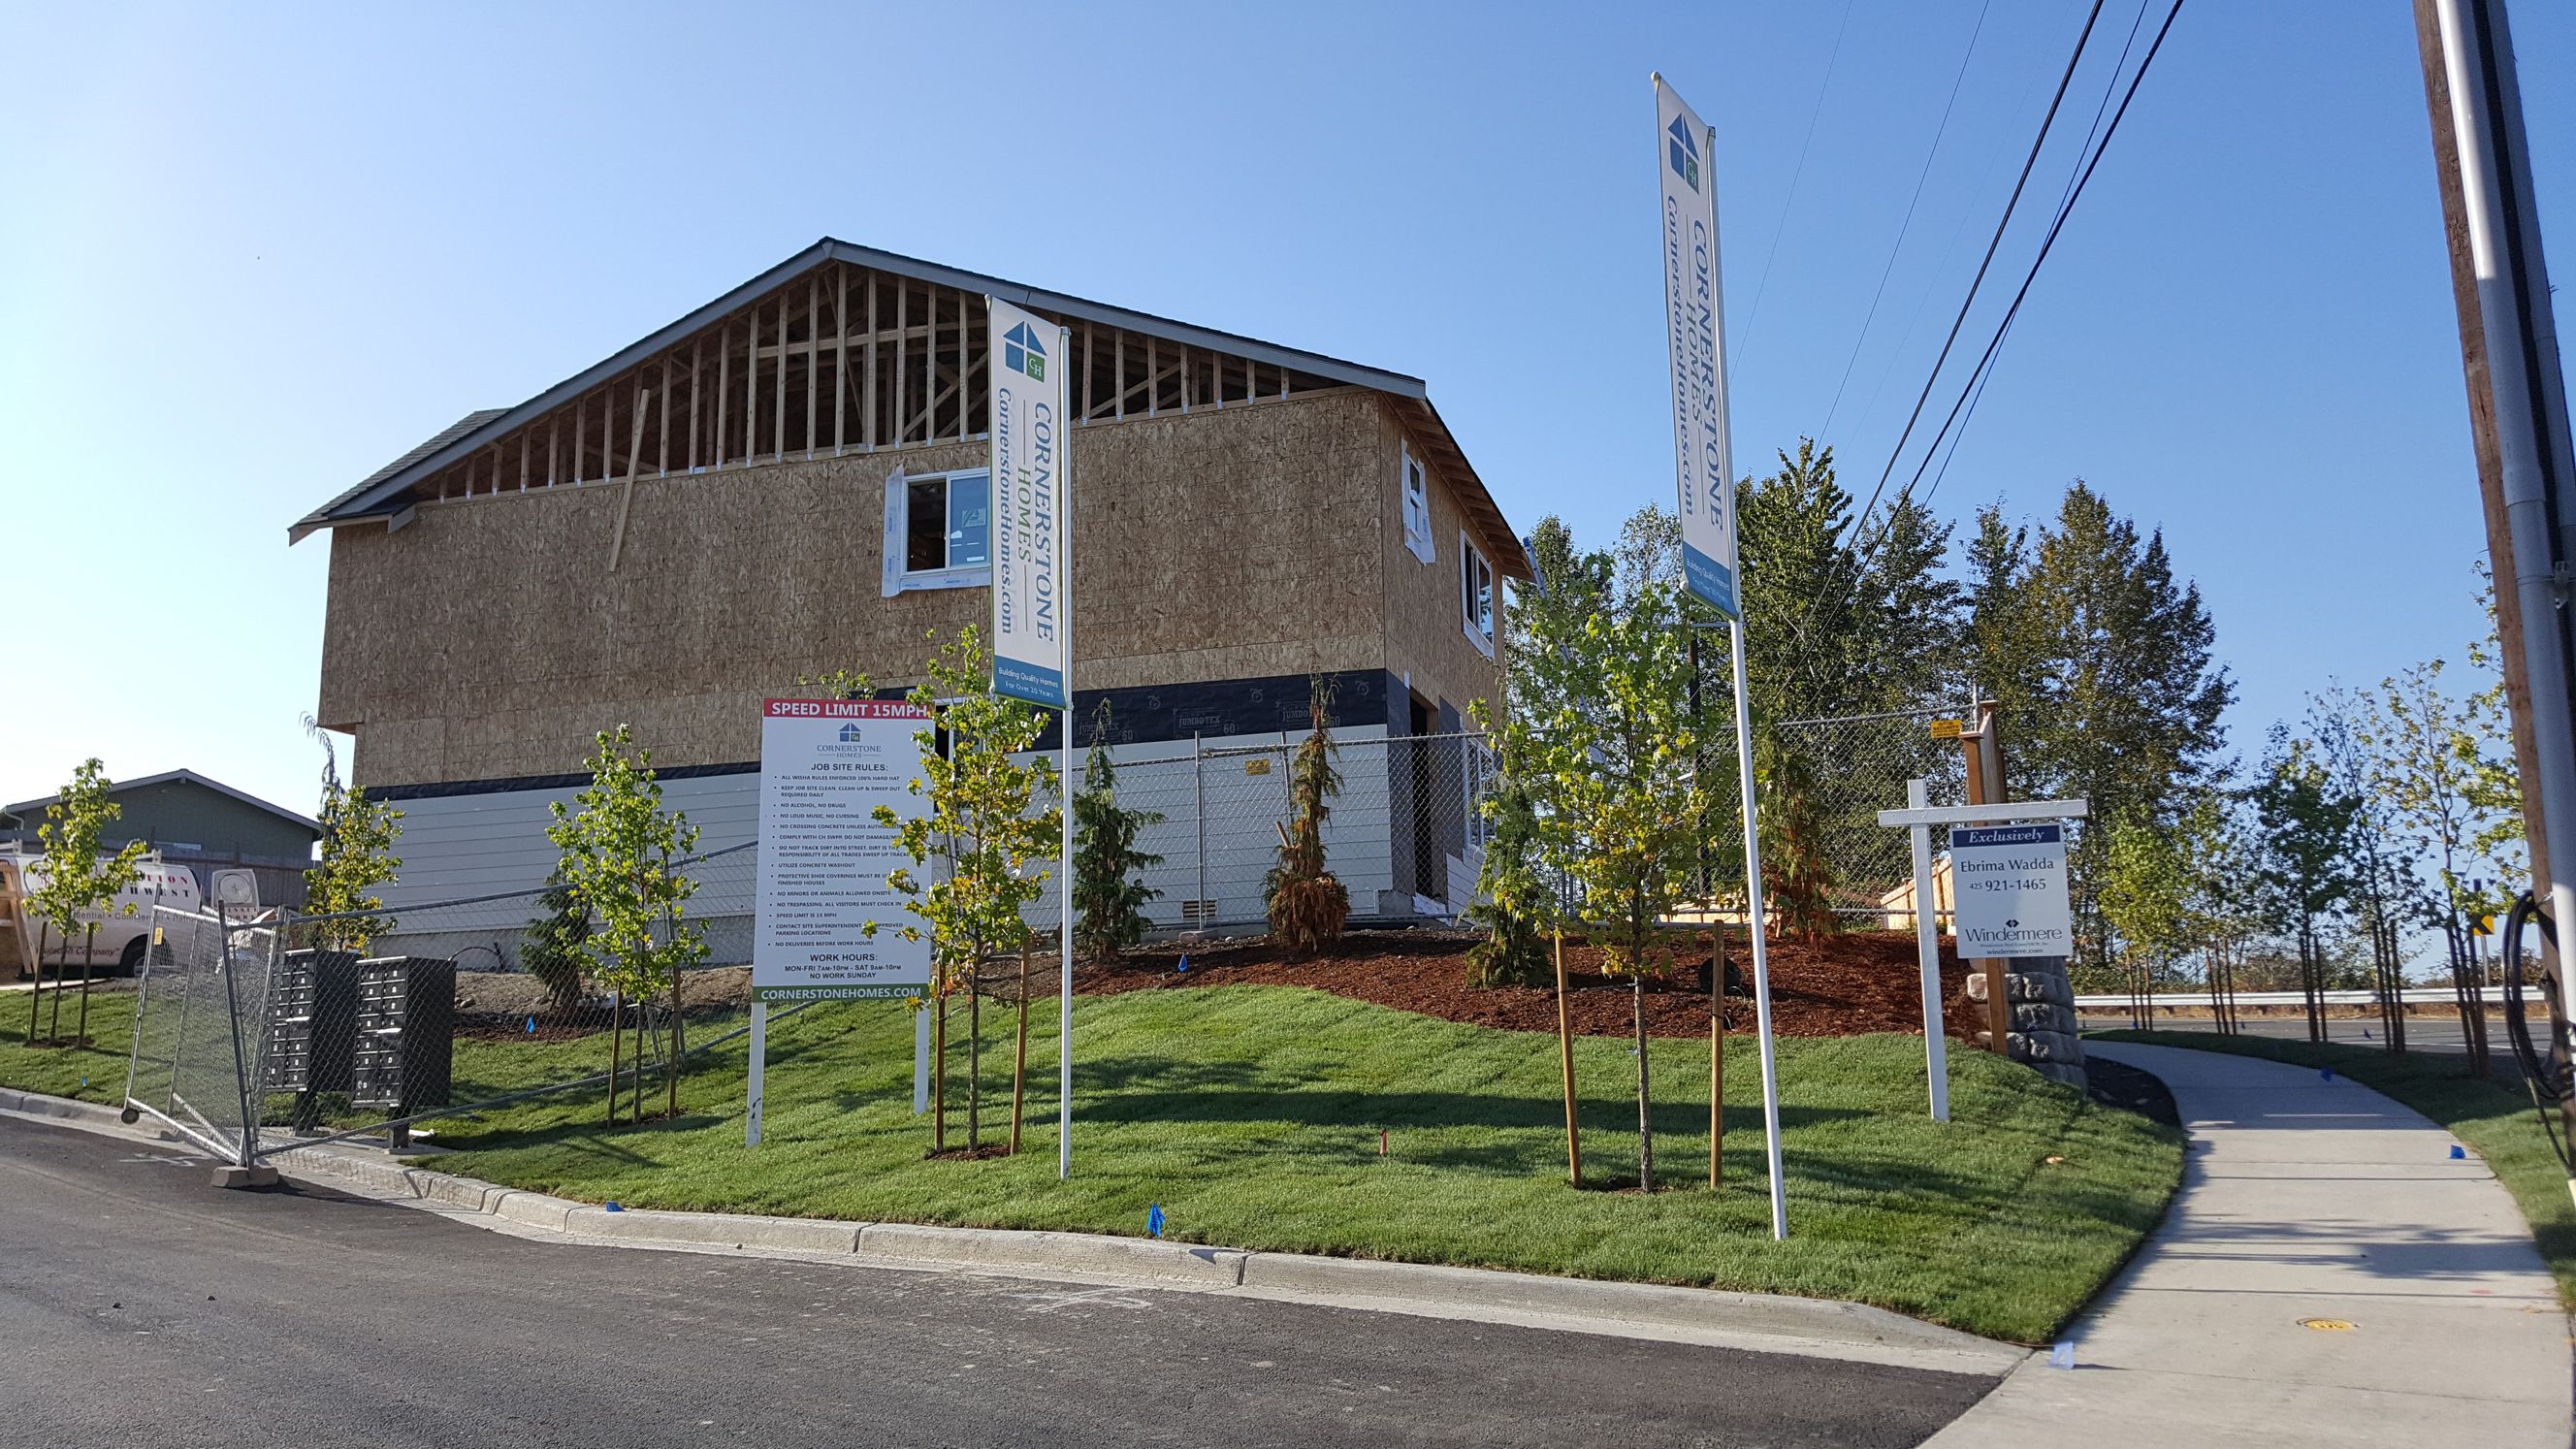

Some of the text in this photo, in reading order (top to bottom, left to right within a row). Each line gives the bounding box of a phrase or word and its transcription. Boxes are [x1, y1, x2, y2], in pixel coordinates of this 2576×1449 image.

[1667, 195, 1693, 516] CornerstoneHomes.com
[1686, 298, 1703, 426] HOMES
[1028, 358, 1042, 376] CH
[1693, 220, 1723, 531] CORNERSTONE
[999, 387, 1012, 634] CornerstoneHomes.com
[1017, 466, 1031, 563] HOMES
[1034, 402, 1053, 642] CORNERSTONE
[998, 666, 1058, 689] Building Quality Homes
[1015, 683, 1029, 692] Over
[1038, 689, 1054, 698] Years
[772, 702, 927, 718] SPEED LIMIT 15MPH
[817, 744, 882, 753] CORNERSTONE
[811, 762, 888, 772] JOB SITE RULES:
[1969, 828, 2045, 844] Exclusively
[1960, 857, 2054, 873] Ebrima Wadda
[1985, 878, 2046, 891] 921-1465
[1965, 927, 2063, 942] Windermere
[810, 953, 840, 962] WORK
[760, 986, 921, 1000] CORNERSTONEHOMES.COM
